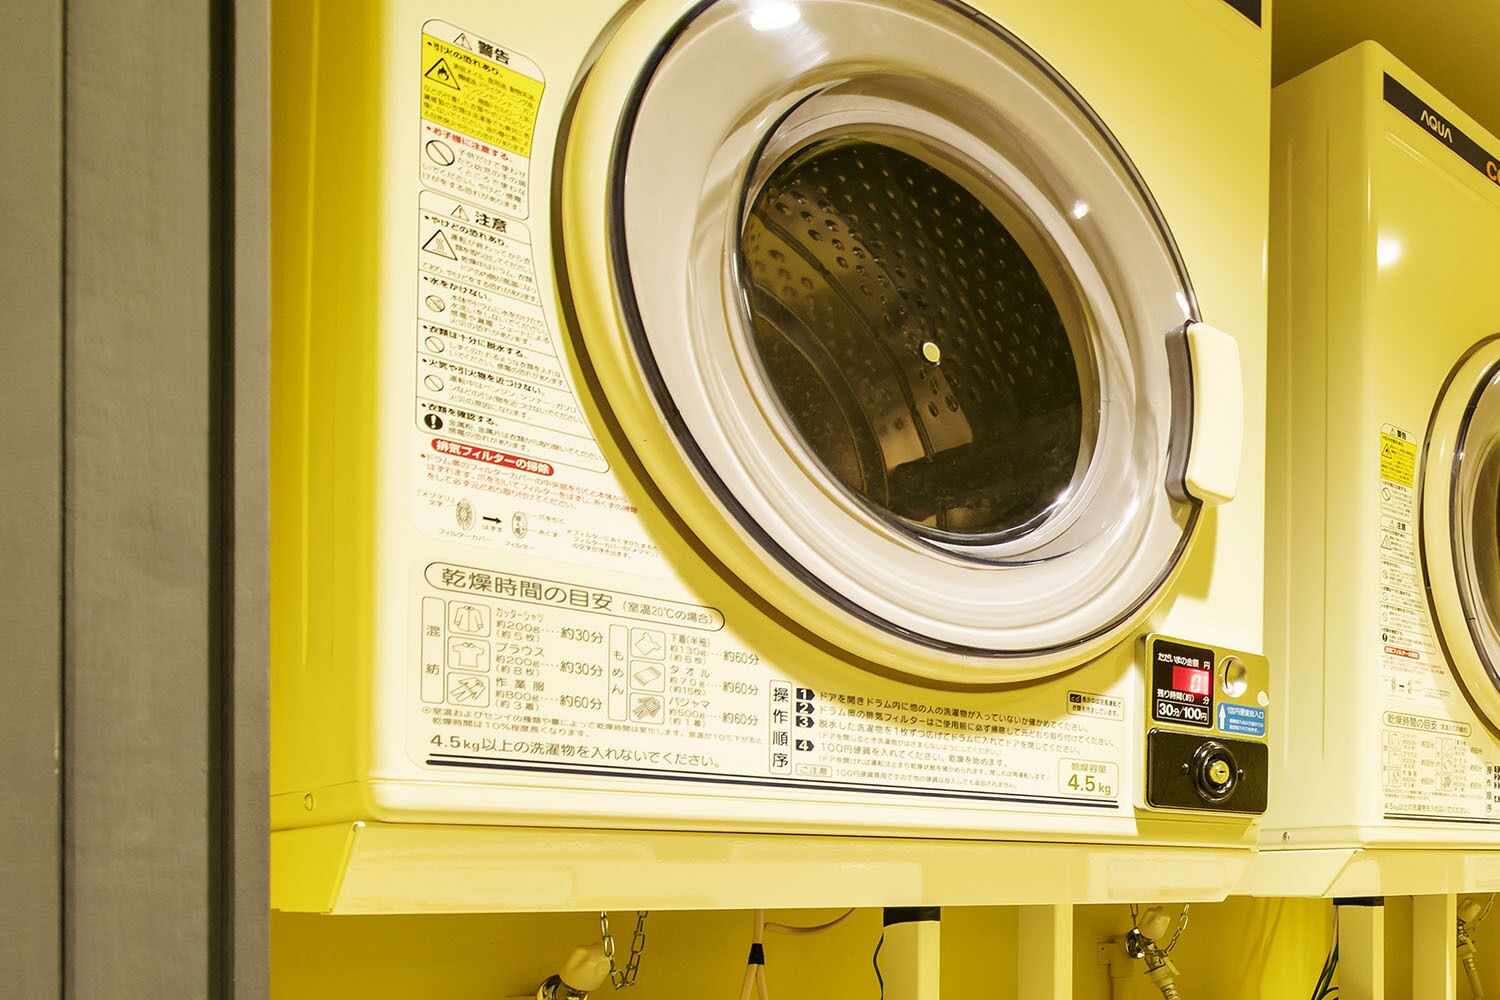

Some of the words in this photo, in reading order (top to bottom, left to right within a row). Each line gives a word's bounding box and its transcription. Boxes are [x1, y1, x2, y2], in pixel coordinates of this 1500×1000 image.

[1420, 109, 1453, 143] AQUA
[475, 211, 507, 233] 注意
[436, 438, 551, 475] 排気フィルターの掃除
[441, 567, 613, 612] 乾燥時間の目安
[560, 626, 604, 644] 約30分
[723, 650, 760, 666] 約60分
[559, 661, 603, 677] 約30分
[722, 681, 759, 696] 約60分
[559, 694, 603, 711] 約60分
[1203, 696, 1210, 705] 分
[722, 712, 759, 727] 約60分
[1158, 702, 1208, 721] 30分/100円
[772, 686, 789, 768] 操作順序
[430, 734, 720, 768] 4.5kg以上の洗濯物を入れないでください。
